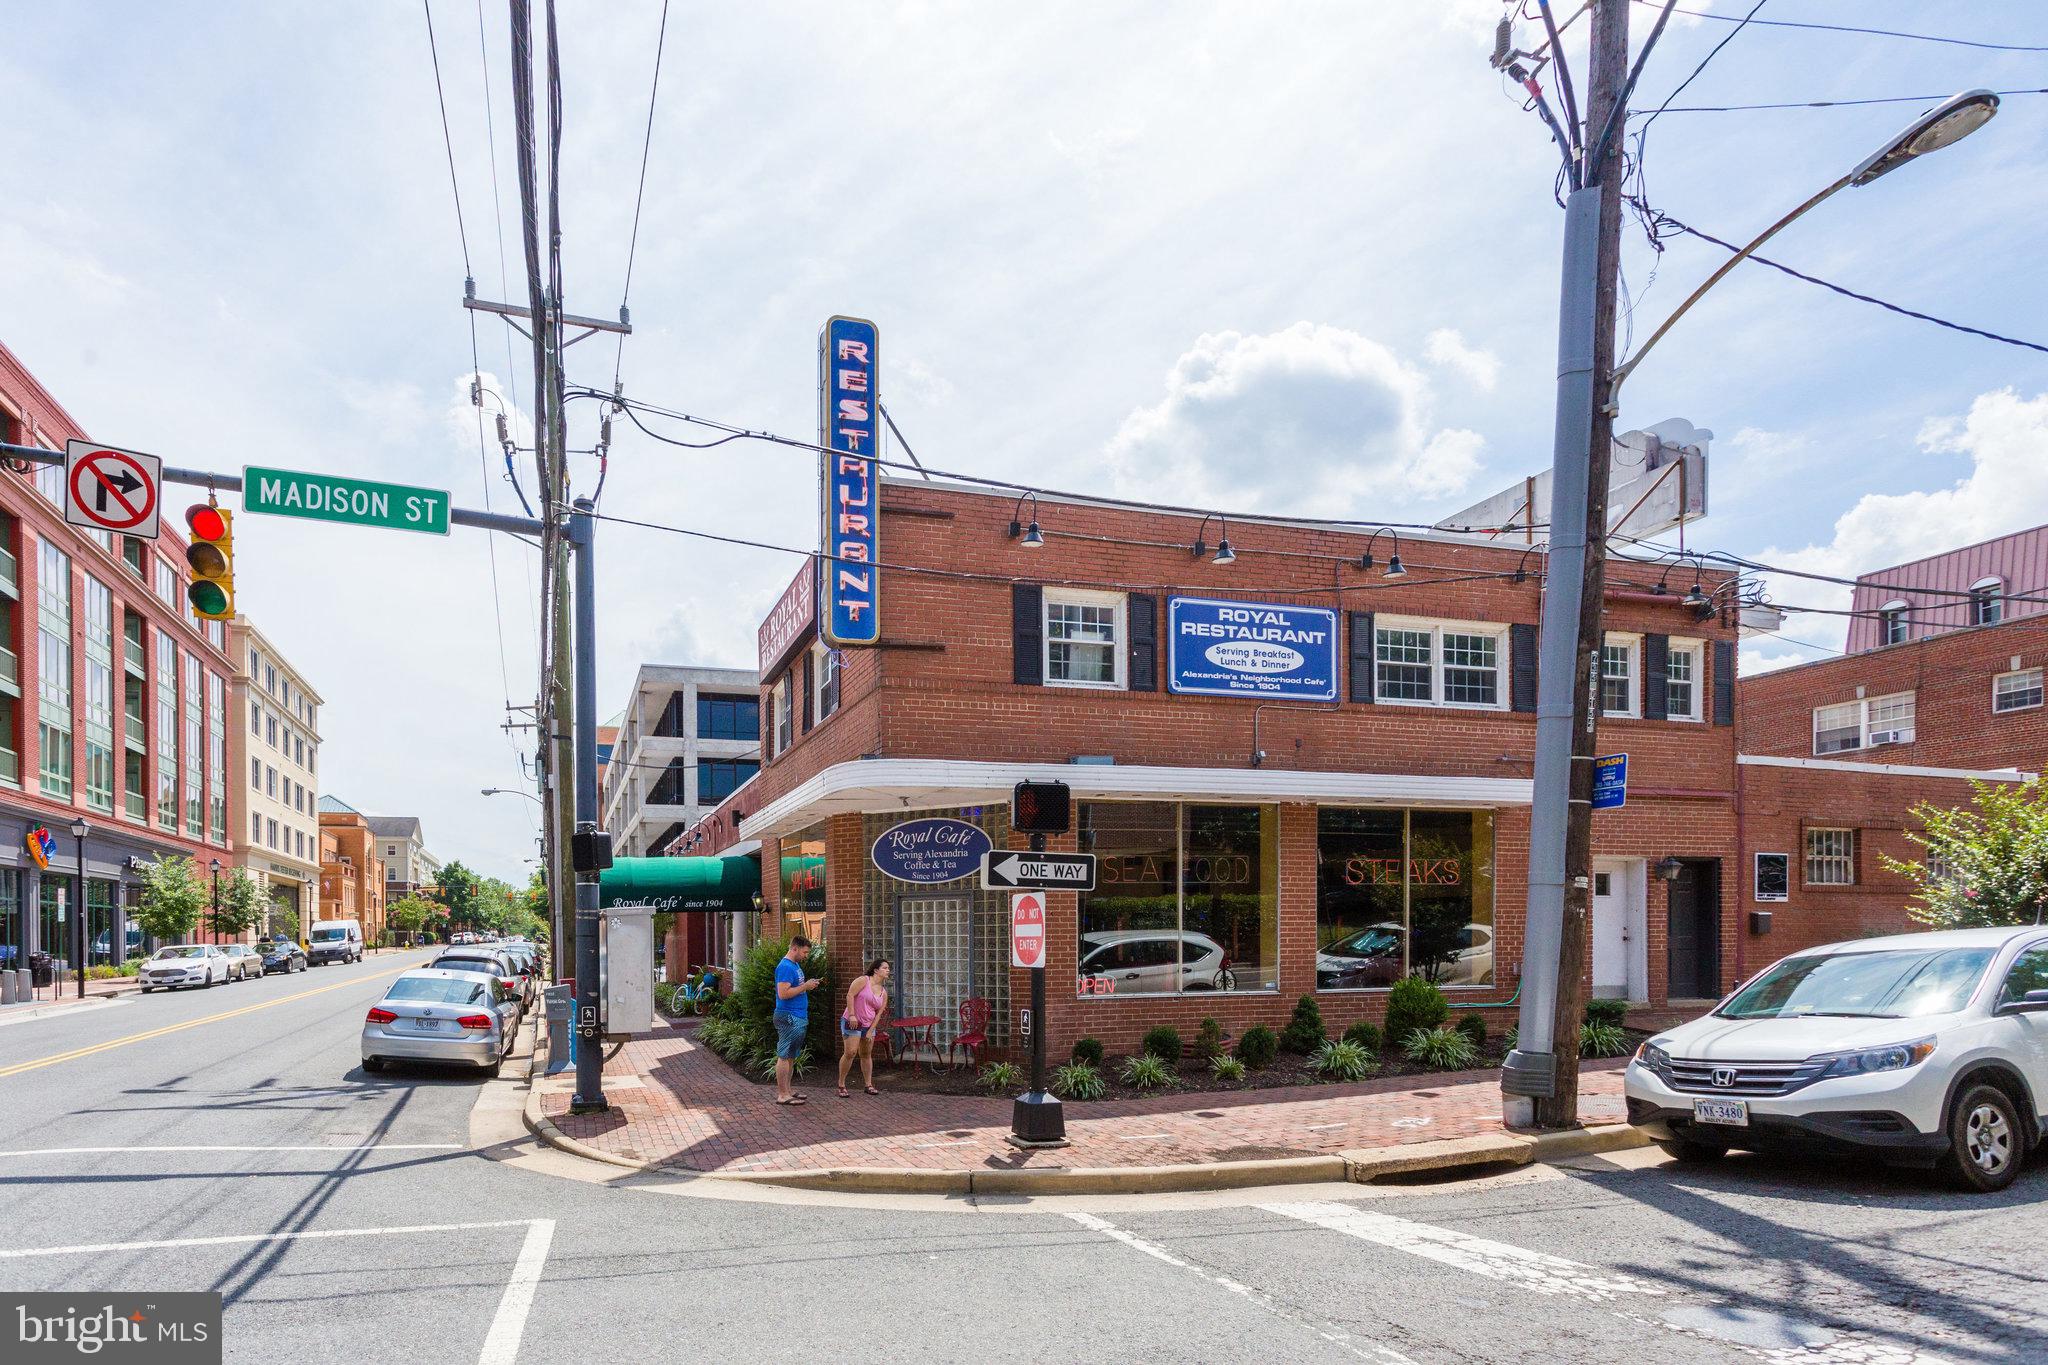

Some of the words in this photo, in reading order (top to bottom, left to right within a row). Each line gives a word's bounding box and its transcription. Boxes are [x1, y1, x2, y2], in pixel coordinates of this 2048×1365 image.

[839, 339, 870, 622] RESTAURANT
[260, 477, 388, 518] MADISON
[405, 496, 438, 524] ST
[770, 587, 798, 640] ROYAL
[1219, 608, 1291, 626] ROYAL
[762, 595, 809, 671] RESTAURANT
[1181, 622, 1326, 645] RESTAURANT
[1215, 646, 1250, 658] Serving
[1253, 649, 1295, 660] Breakfast
[1220, 657, 1247, 667] Lunch
[1251, 659, 1257, 667] &
[1261, 659, 1290, 669] Dinner
[1182, 670, 1238, 681] Alexandria's
[1597, 757, 1624, 767] DASH
[889, 827, 933, 850] Royal
[935, 825, 976, 846] Café
[893, 850, 923, 860] Serving
[925, 848, 968, 859] Alexandria
[904, 861, 930, 870] Coffee
[932, 861, 940, 869] &
[943, 860, 957, 869] Tea
[1020, 863, 1048, 877] ONE
[1054, 864, 1083, 879] WAY
[1104, 855, 1160, 883] SEA
[1347, 859, 1459, 884] STEAKS
[912, 871, 930, 880] Since
[932, 871, 949, 880] 1904
[685, 900, 704, 908] since
[705, 900, 723, 908] 1904
[1017, 909, 1025, 920] DO
[1029, 908, 1039, 919] NOT
[1019, 939, 1037, 950] ENTER
[1697, 1105, 1743, 1118] VNK-3480
